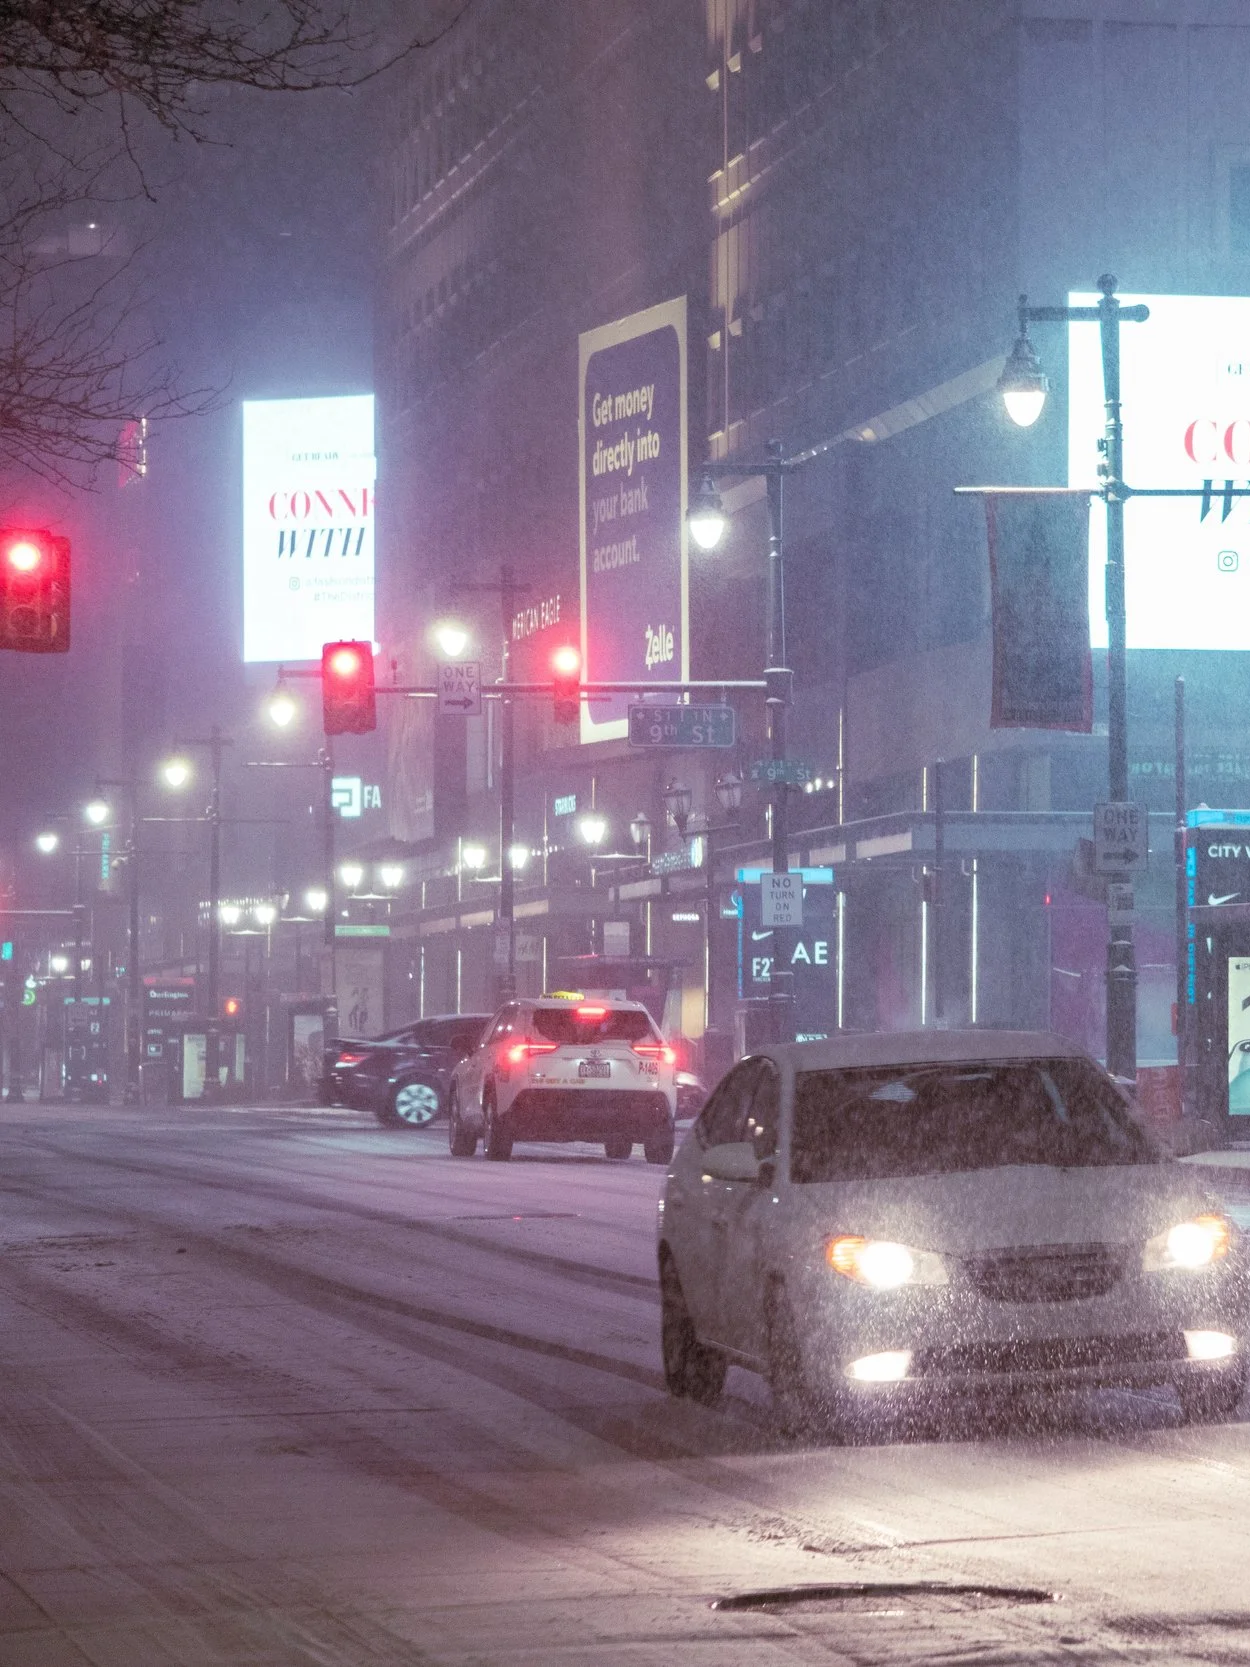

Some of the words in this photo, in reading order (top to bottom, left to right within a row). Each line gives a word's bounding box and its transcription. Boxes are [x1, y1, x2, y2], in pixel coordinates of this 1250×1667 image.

[593, 392, 613, 427] Get
[615, 384, 655, 421] money
[593, 431, 635, 477] directly
[637, 427, 660, 463] into
[593, 494, 621, 535] your
[620, 475, 649, 517] bank
[277, 527, 365, 558] WITH
[593, 534, 641, 573] account.
[645, 624, 675, 670] Zelle
[443, 666, 474, 679] ONE
[443, 680, 474, 694] WAY
[650, 724, 678, 743] 9th
[691, 725, 716, 744] St
[1103, 807, 1140, 825] ONE
[1102, 827, 1138, 843] WAY
[1207, 846, 1242, 859] CITY
[772, 878, 792, 889] NO
[769, 891, 795, 900] TURN
[775, 903, 790, 912] ON
[772, 914, 793, 923] RED
[790, 941, 828, 965] AE
[752, 957, 775, 978] F2
